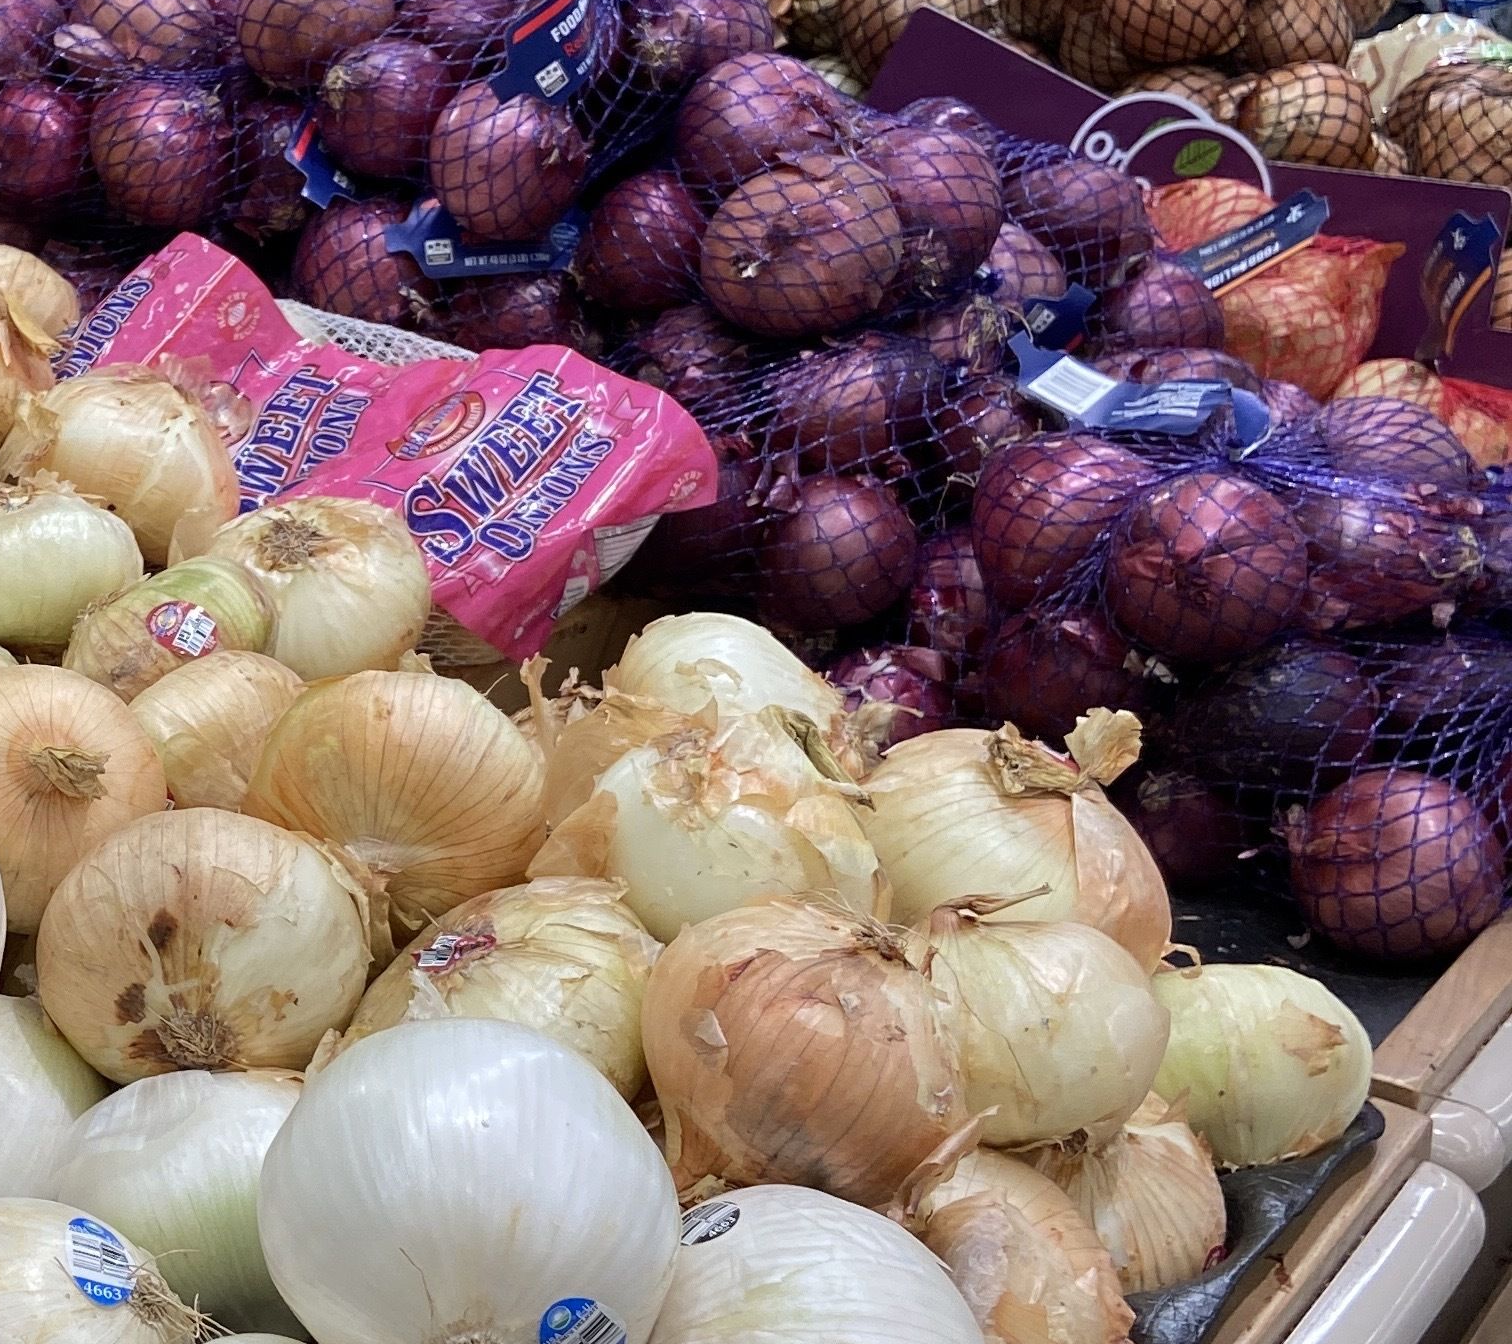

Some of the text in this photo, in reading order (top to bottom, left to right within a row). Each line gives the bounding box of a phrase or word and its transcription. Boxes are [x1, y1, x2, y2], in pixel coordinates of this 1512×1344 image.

[403, 370, 586, 566] SWEET
[476, 429, 616, 562] ONIONS
[83, 1281, 123, 1301] 4663
